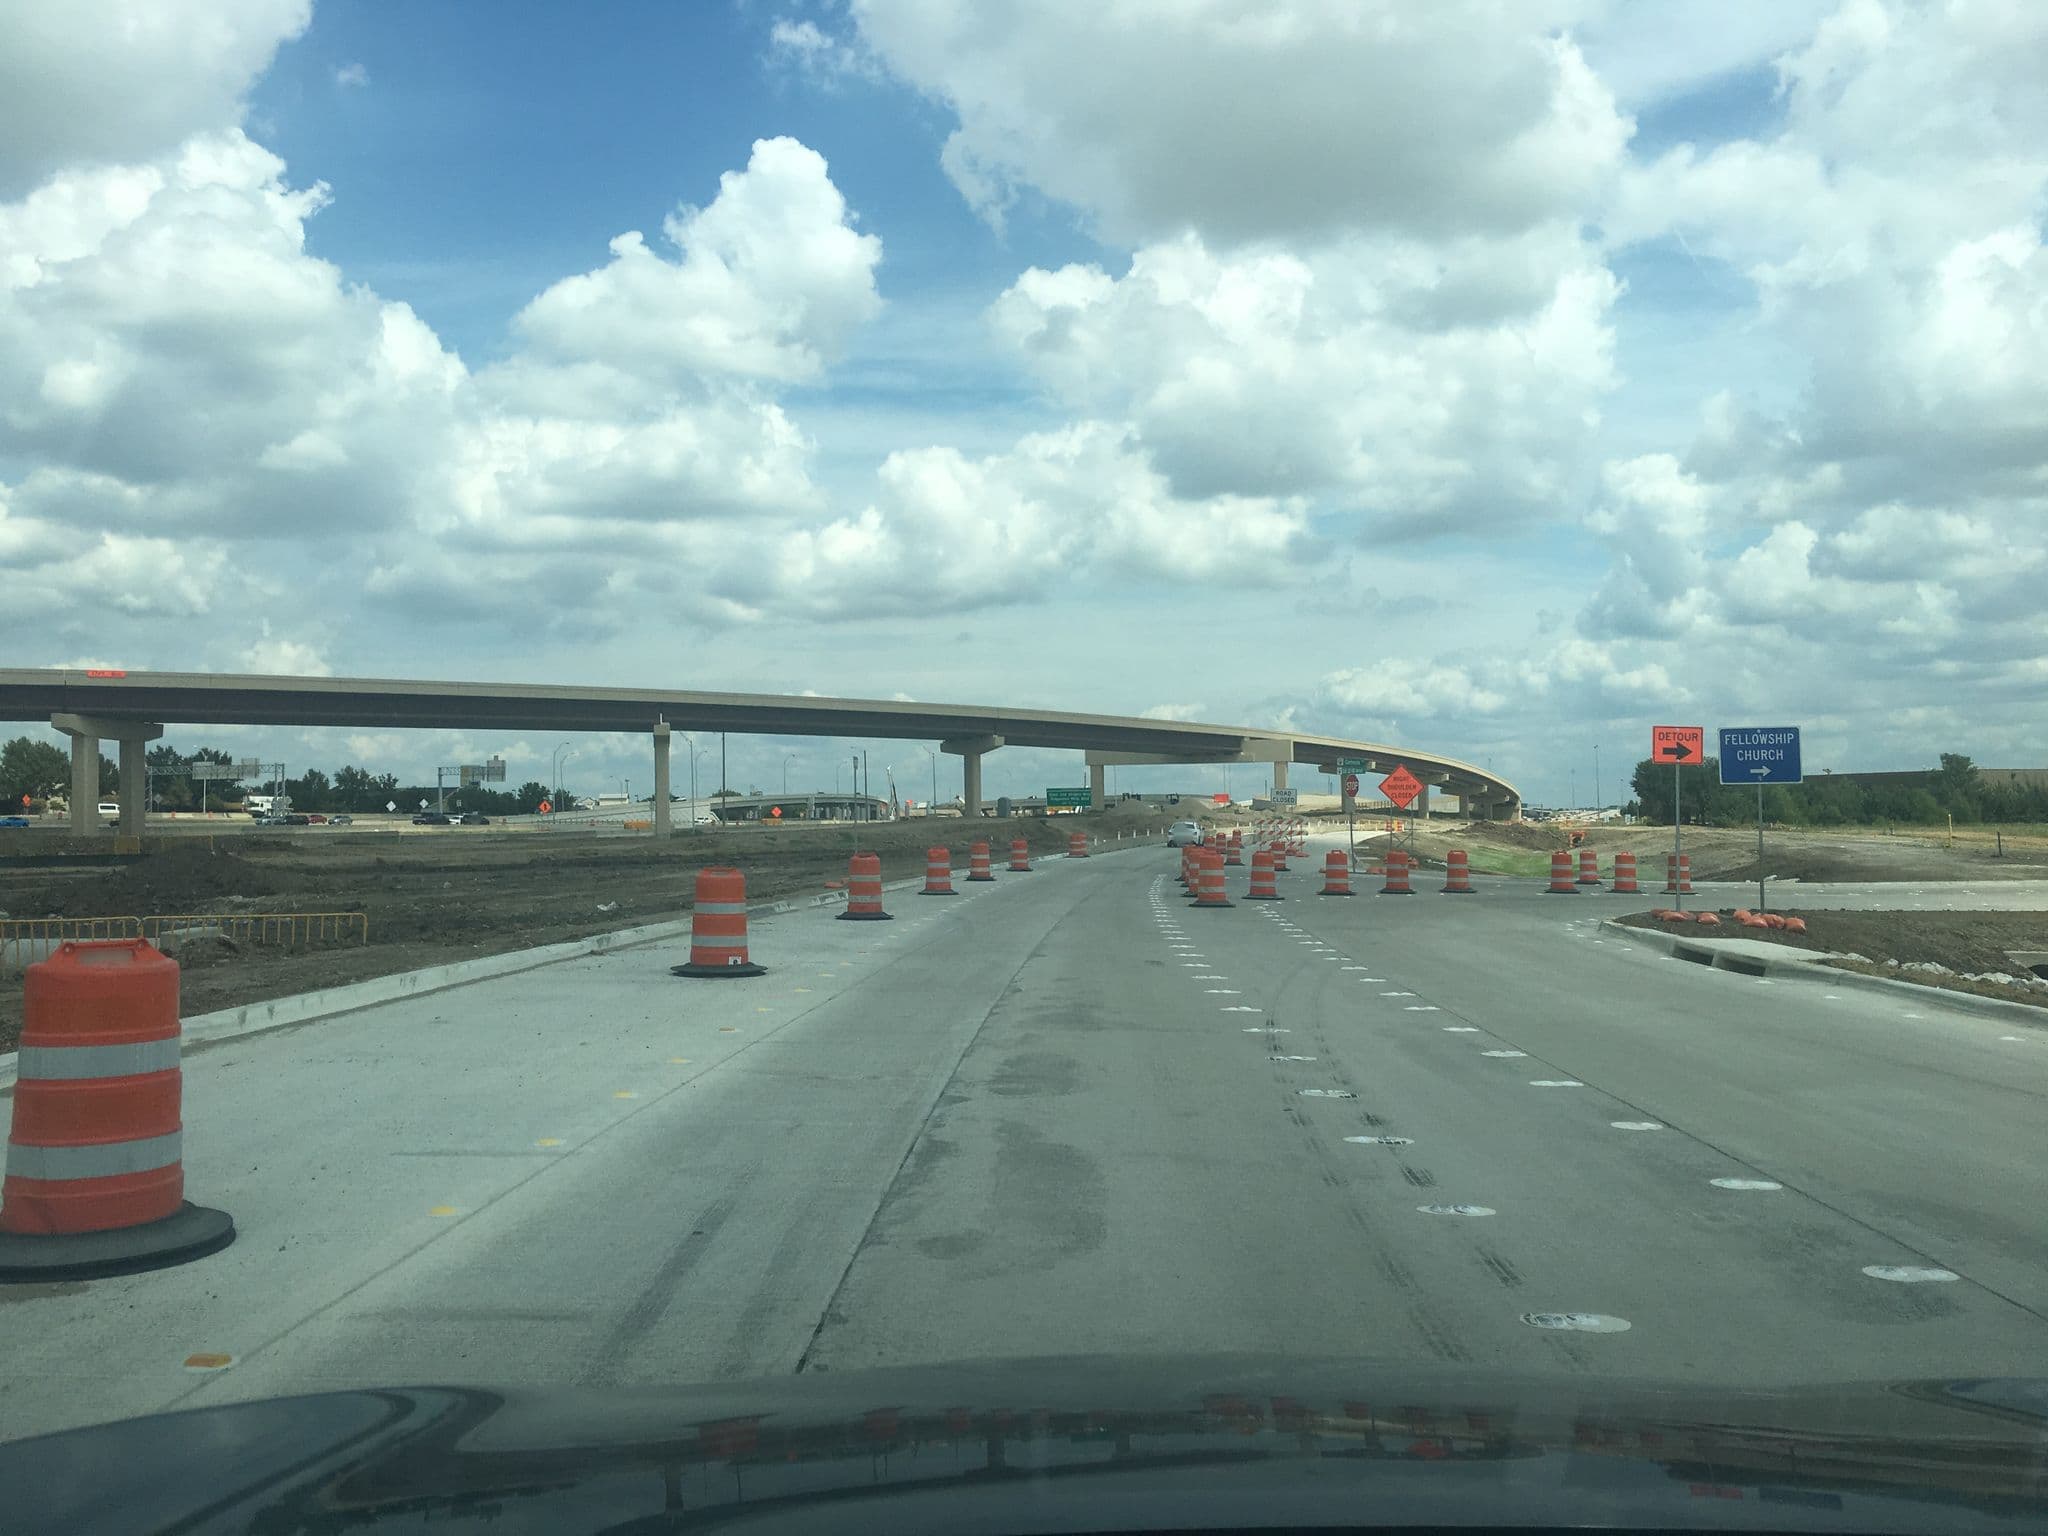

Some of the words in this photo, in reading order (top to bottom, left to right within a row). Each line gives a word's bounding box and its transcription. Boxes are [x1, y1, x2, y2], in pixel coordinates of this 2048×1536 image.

[1658, 731, 1698, 742] DETOUR
[1724, 733, 1794, 745] FELLOWSHIP
[1737, 750, 1784, 761] CHURCH
[1346, 781, 1359, 791] STOP
